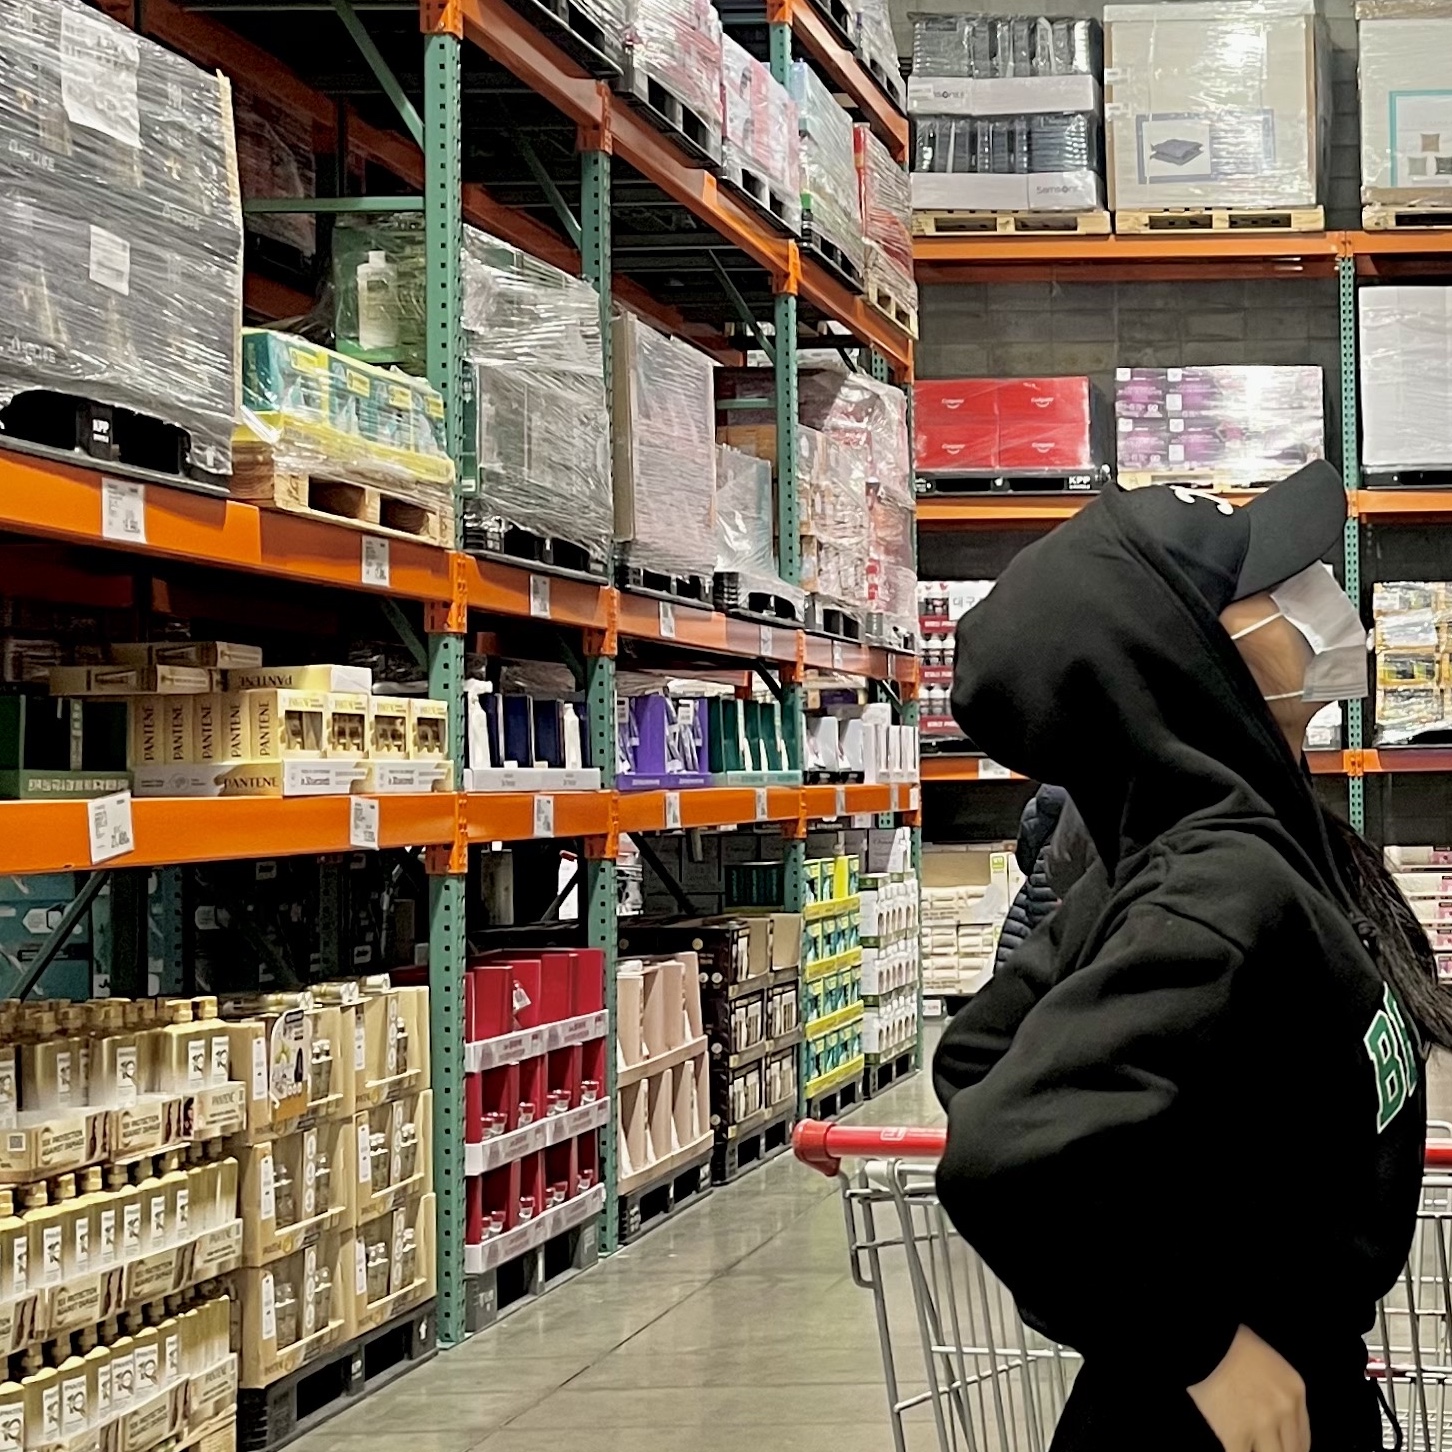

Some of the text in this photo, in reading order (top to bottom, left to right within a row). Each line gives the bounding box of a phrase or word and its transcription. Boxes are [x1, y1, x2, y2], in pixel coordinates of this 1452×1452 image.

[143, 705, 155, 761] PANTENE
[173, 704, 185, 761] PANTENE
[202, 705, 214, 760] PANTENE
[230, 702, 242, 759] PANTENE
[258, 700, 271, 757] PANTENE
[223, 776, 278, 792] PANTENE
